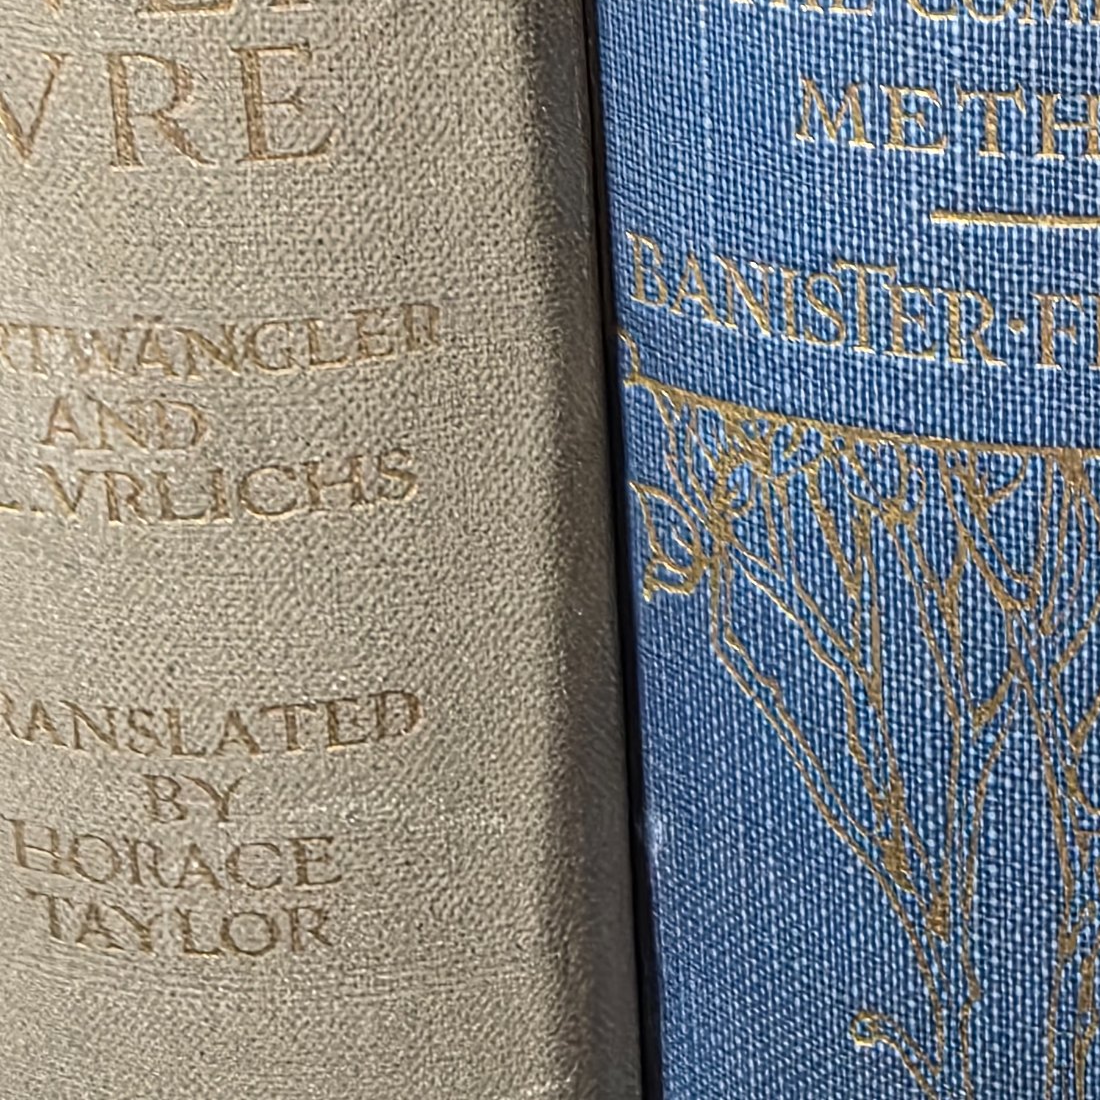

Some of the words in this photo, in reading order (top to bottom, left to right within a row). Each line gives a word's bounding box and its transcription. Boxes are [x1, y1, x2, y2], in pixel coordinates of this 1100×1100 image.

[40, 395, 210, 453] AND
[143, 772, 247, 824] BY
[1, 811, 344, 894] HORACE
[25, 885, 335, 960] TAYLOR
